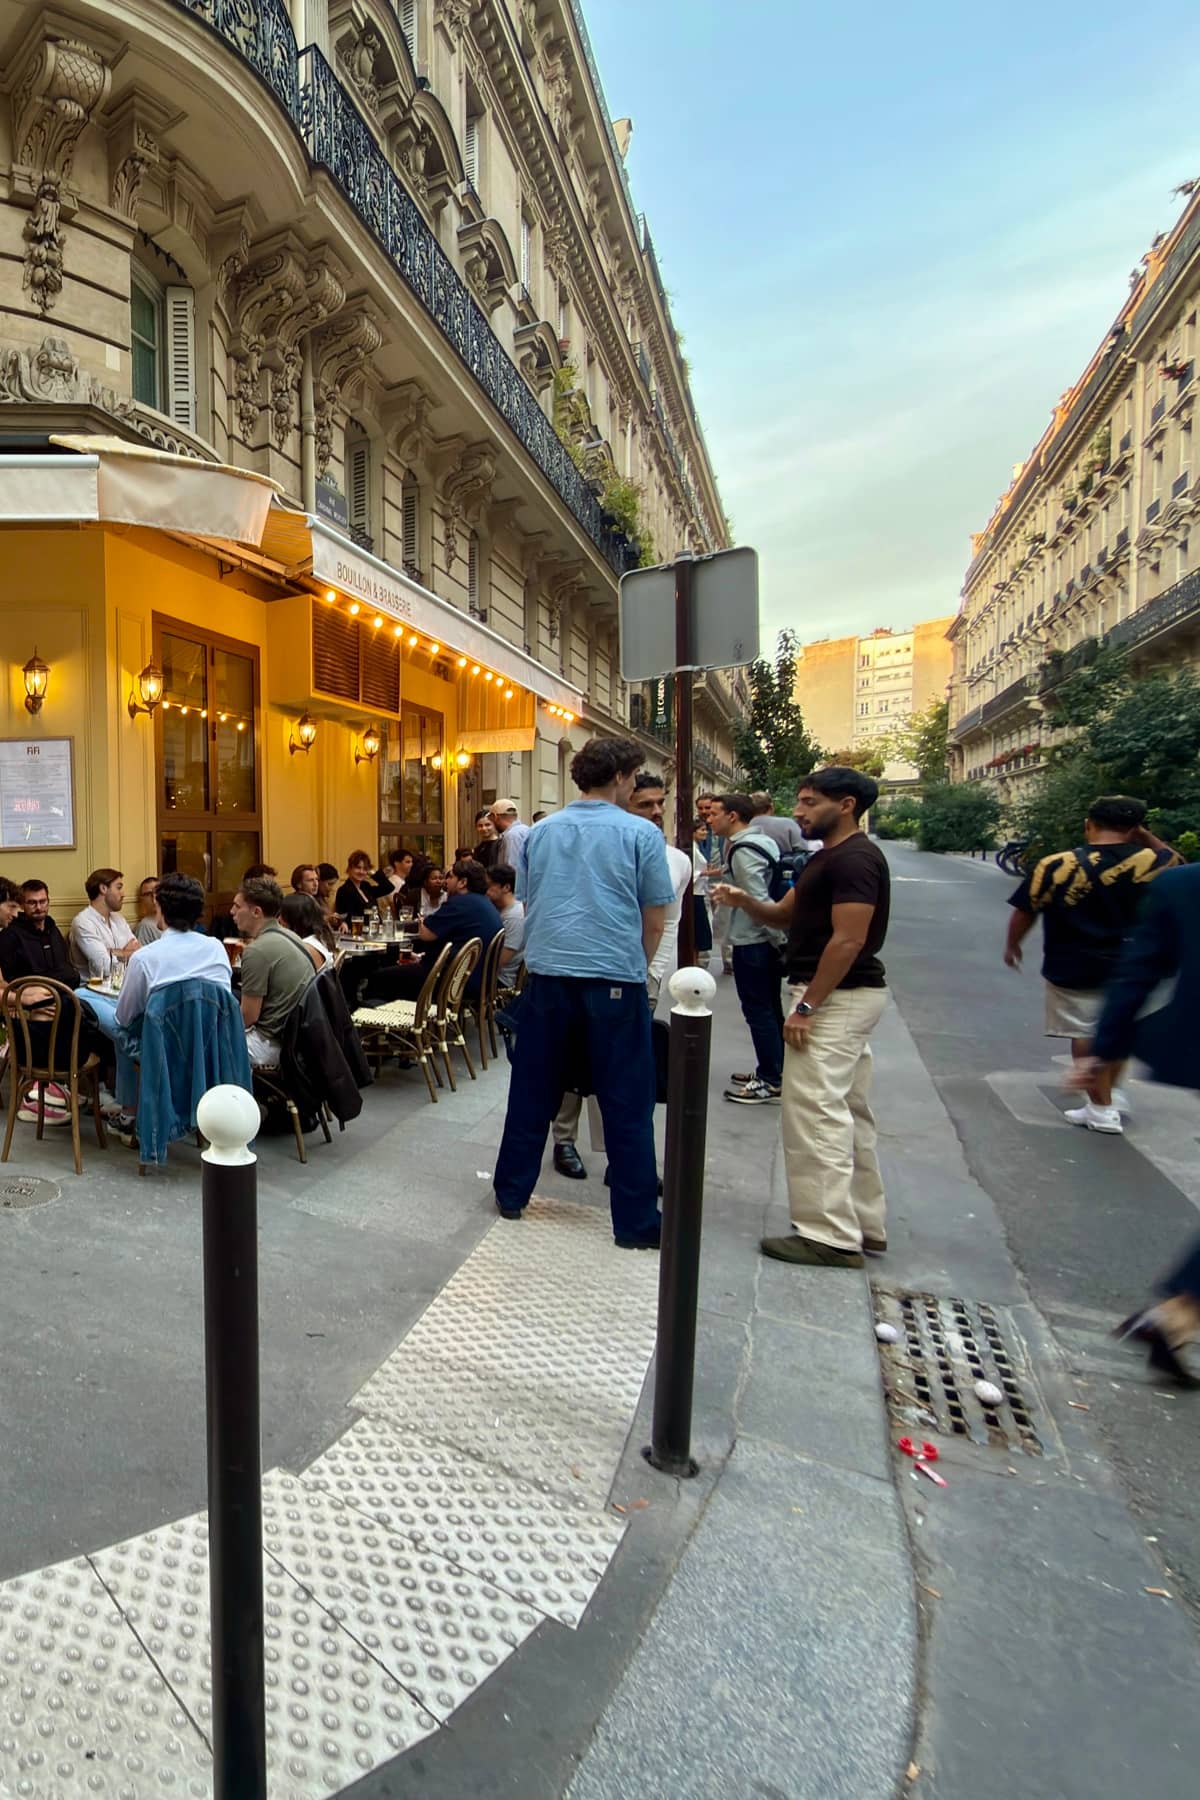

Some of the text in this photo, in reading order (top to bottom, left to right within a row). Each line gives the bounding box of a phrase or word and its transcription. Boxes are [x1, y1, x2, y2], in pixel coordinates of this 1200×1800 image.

[336, 561, 412, 617] BOUILLON & BRASSERIE
